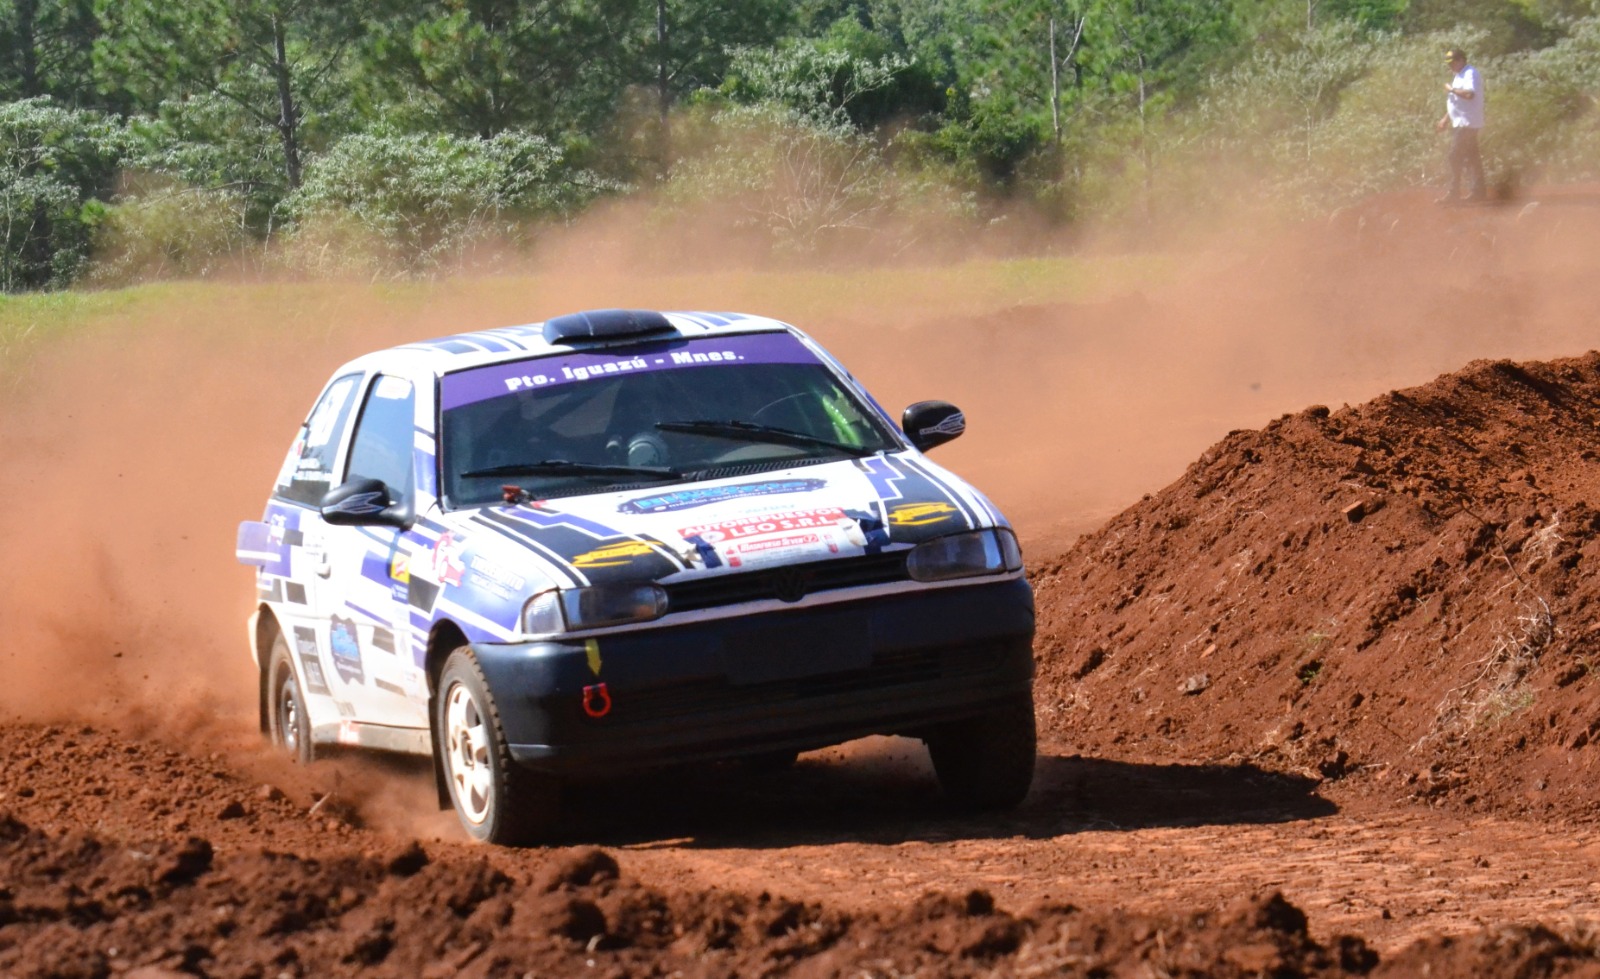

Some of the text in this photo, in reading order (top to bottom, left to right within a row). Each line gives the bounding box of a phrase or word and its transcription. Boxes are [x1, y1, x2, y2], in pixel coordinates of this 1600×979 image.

[504, 374, 556, 391] Pto.
[562, 356, 648, 379] Iguazú
[670, 350, 745, 365] Mnes.
[684, 508, 842, 536] AUTOREPUESTOS
[730, 522, 776, 537] LEO
